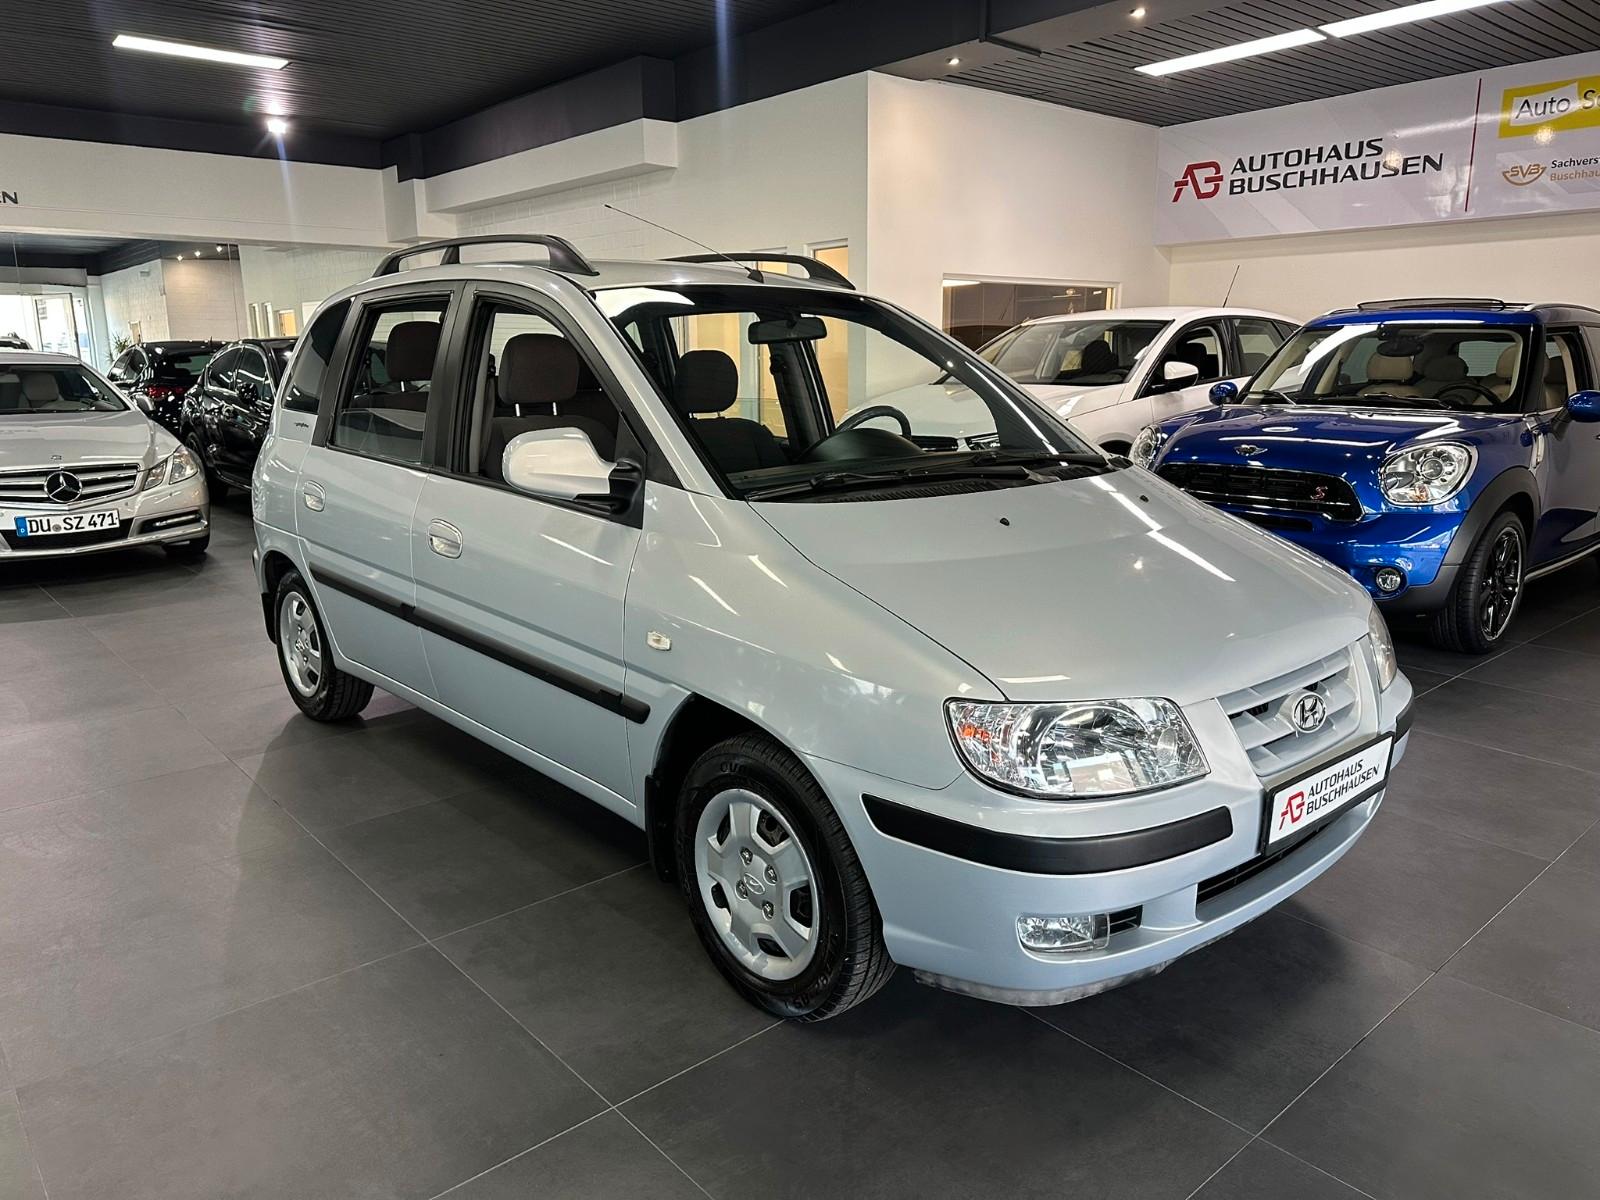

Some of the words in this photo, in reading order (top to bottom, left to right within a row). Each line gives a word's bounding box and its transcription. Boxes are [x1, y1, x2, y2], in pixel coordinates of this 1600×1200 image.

[1515, 97, 1570, 119] Auto
[1229, 153, 1443, 195] BUSCHHAUSEN
[1230, 138, 1384, 174] AUTOHAUS
[1509, 164, 1541, 178] SVB
[29, 519, 50, 534] DU
[63, 516, 85, 531] SZ
[88, 513, 116, 527] 471
[1306, 764, 1380, 815] BUSCHHAUSEN
[1308, 759, 1364, 798] AUTOHAUS
